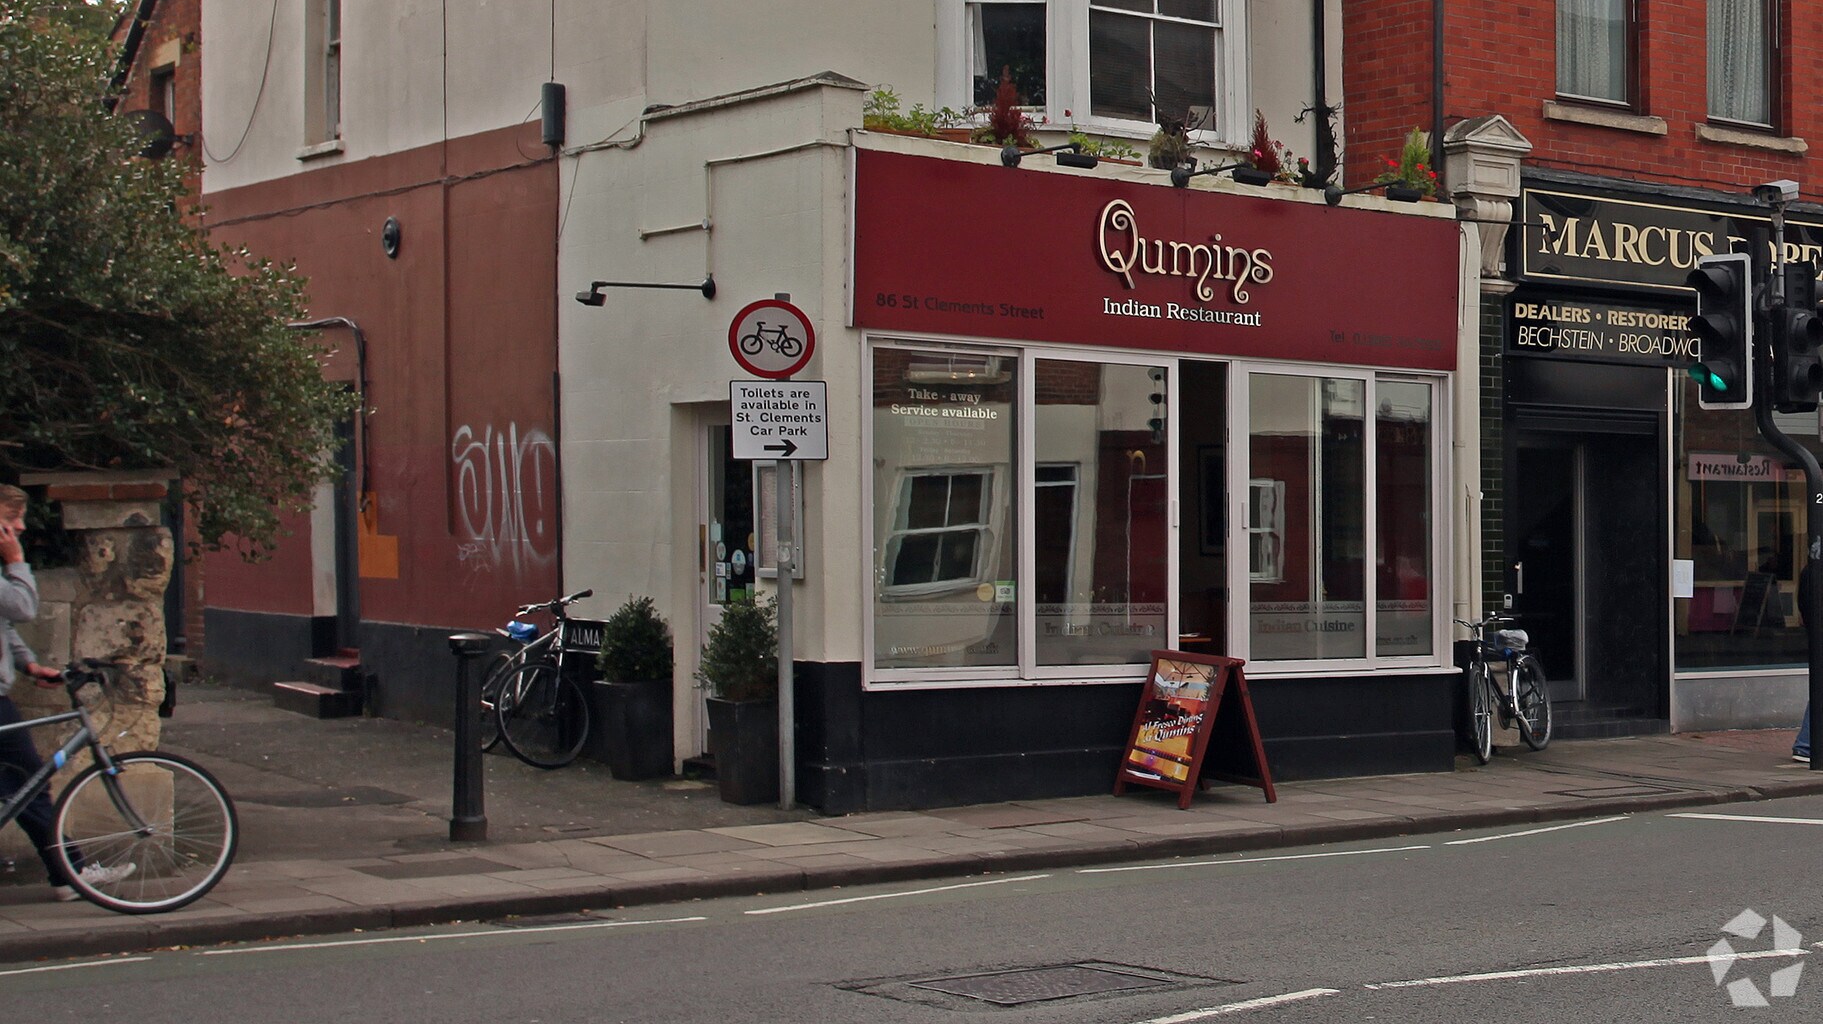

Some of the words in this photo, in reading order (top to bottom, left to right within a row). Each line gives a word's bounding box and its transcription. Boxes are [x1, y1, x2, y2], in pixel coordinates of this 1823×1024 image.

[1538, 213, 1714, 270] MARCUS
[1099, 198, 1274, 304] Qumins
[875, 292, 898, 308] 86
[902, 295, 920, 310] St
[924, 297, 995, 316] Clements
[999, 303, 1045, 320] Street
[1103, 297, 1162, 319] Indian
[1166, 302, 1262, 327] Restaurant
[1514, 302, 1592, 324] DEALERS
[1517, 325, 1604, 351] BECHSTEIN
[740, 387, 784, 398] Toilets
[790, 390, 810, 399] are
[908, 388, 939, 400] Take
[950, 393, 981, 405] away
[740, 399, 799, 410] available
[805, 400, 816, 410] in
[891, 403, 939, 417] Service
[942, 407, 998, 419] available
[736, 412, 754, 423] St.
[759, 412, 822, 423] Clements
[750, 425, 773, 436] Car
[779, 425, 808, 436] Park
[1306, 619, 1356, 633] Cuisine
[570, 627, 601, 646] ALMA
